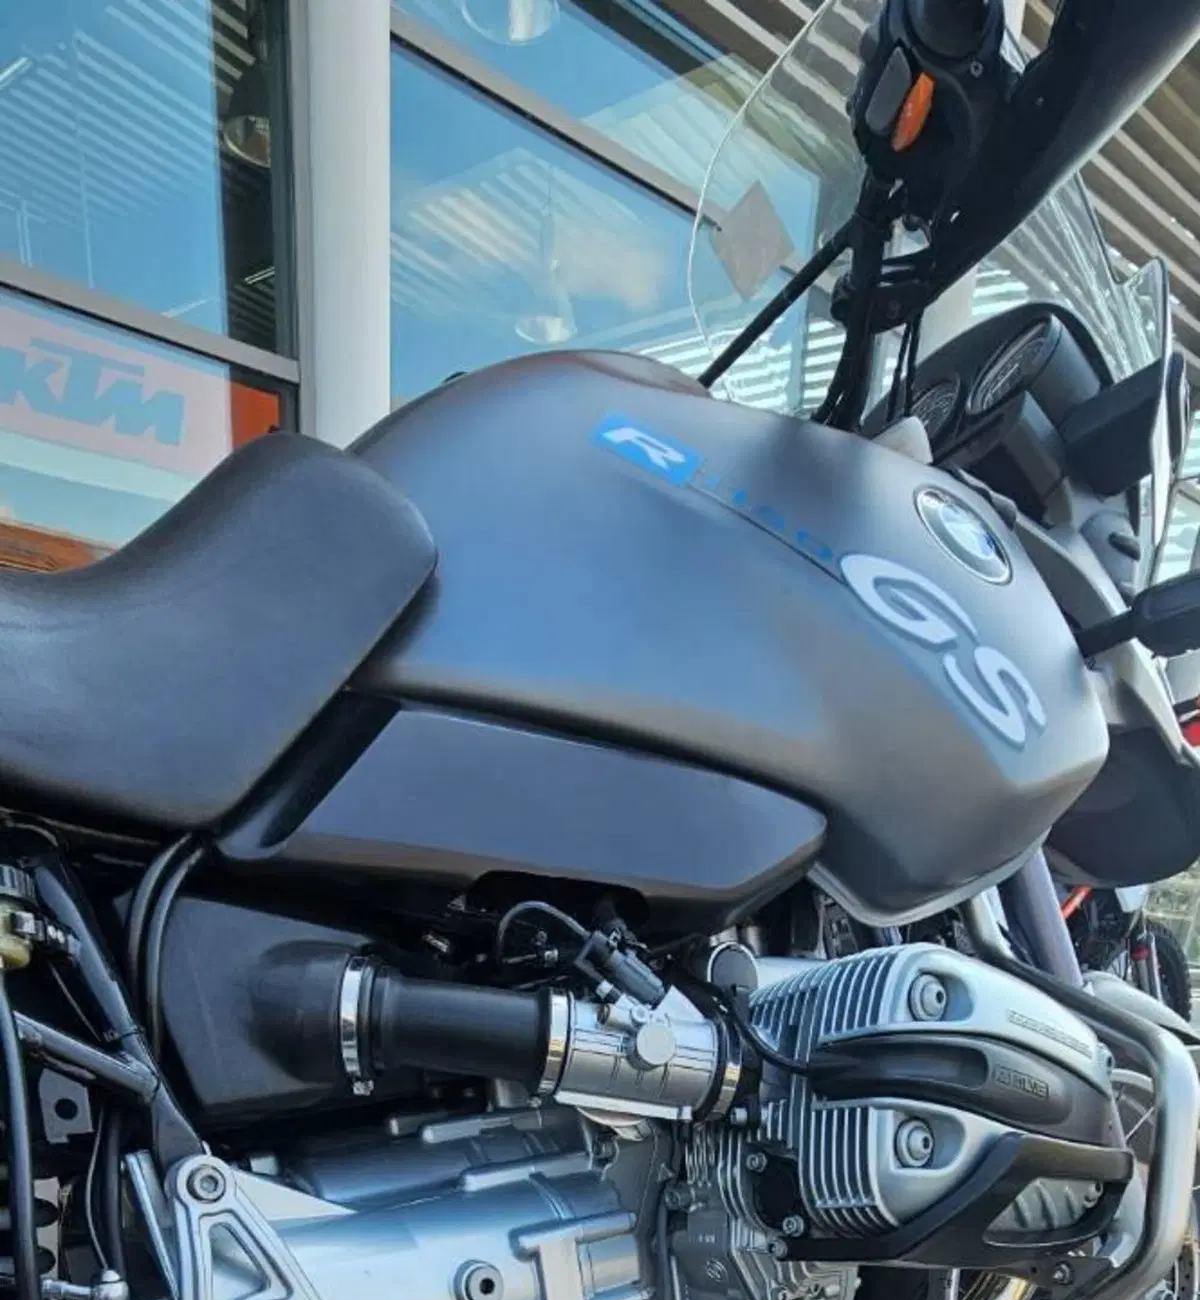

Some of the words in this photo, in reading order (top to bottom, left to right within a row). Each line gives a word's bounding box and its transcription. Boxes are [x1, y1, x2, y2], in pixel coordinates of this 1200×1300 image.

[0, 336, 184, 446] KTM
[600, 426, 685, 471] R
[840, 553, 1047, 747] GS
